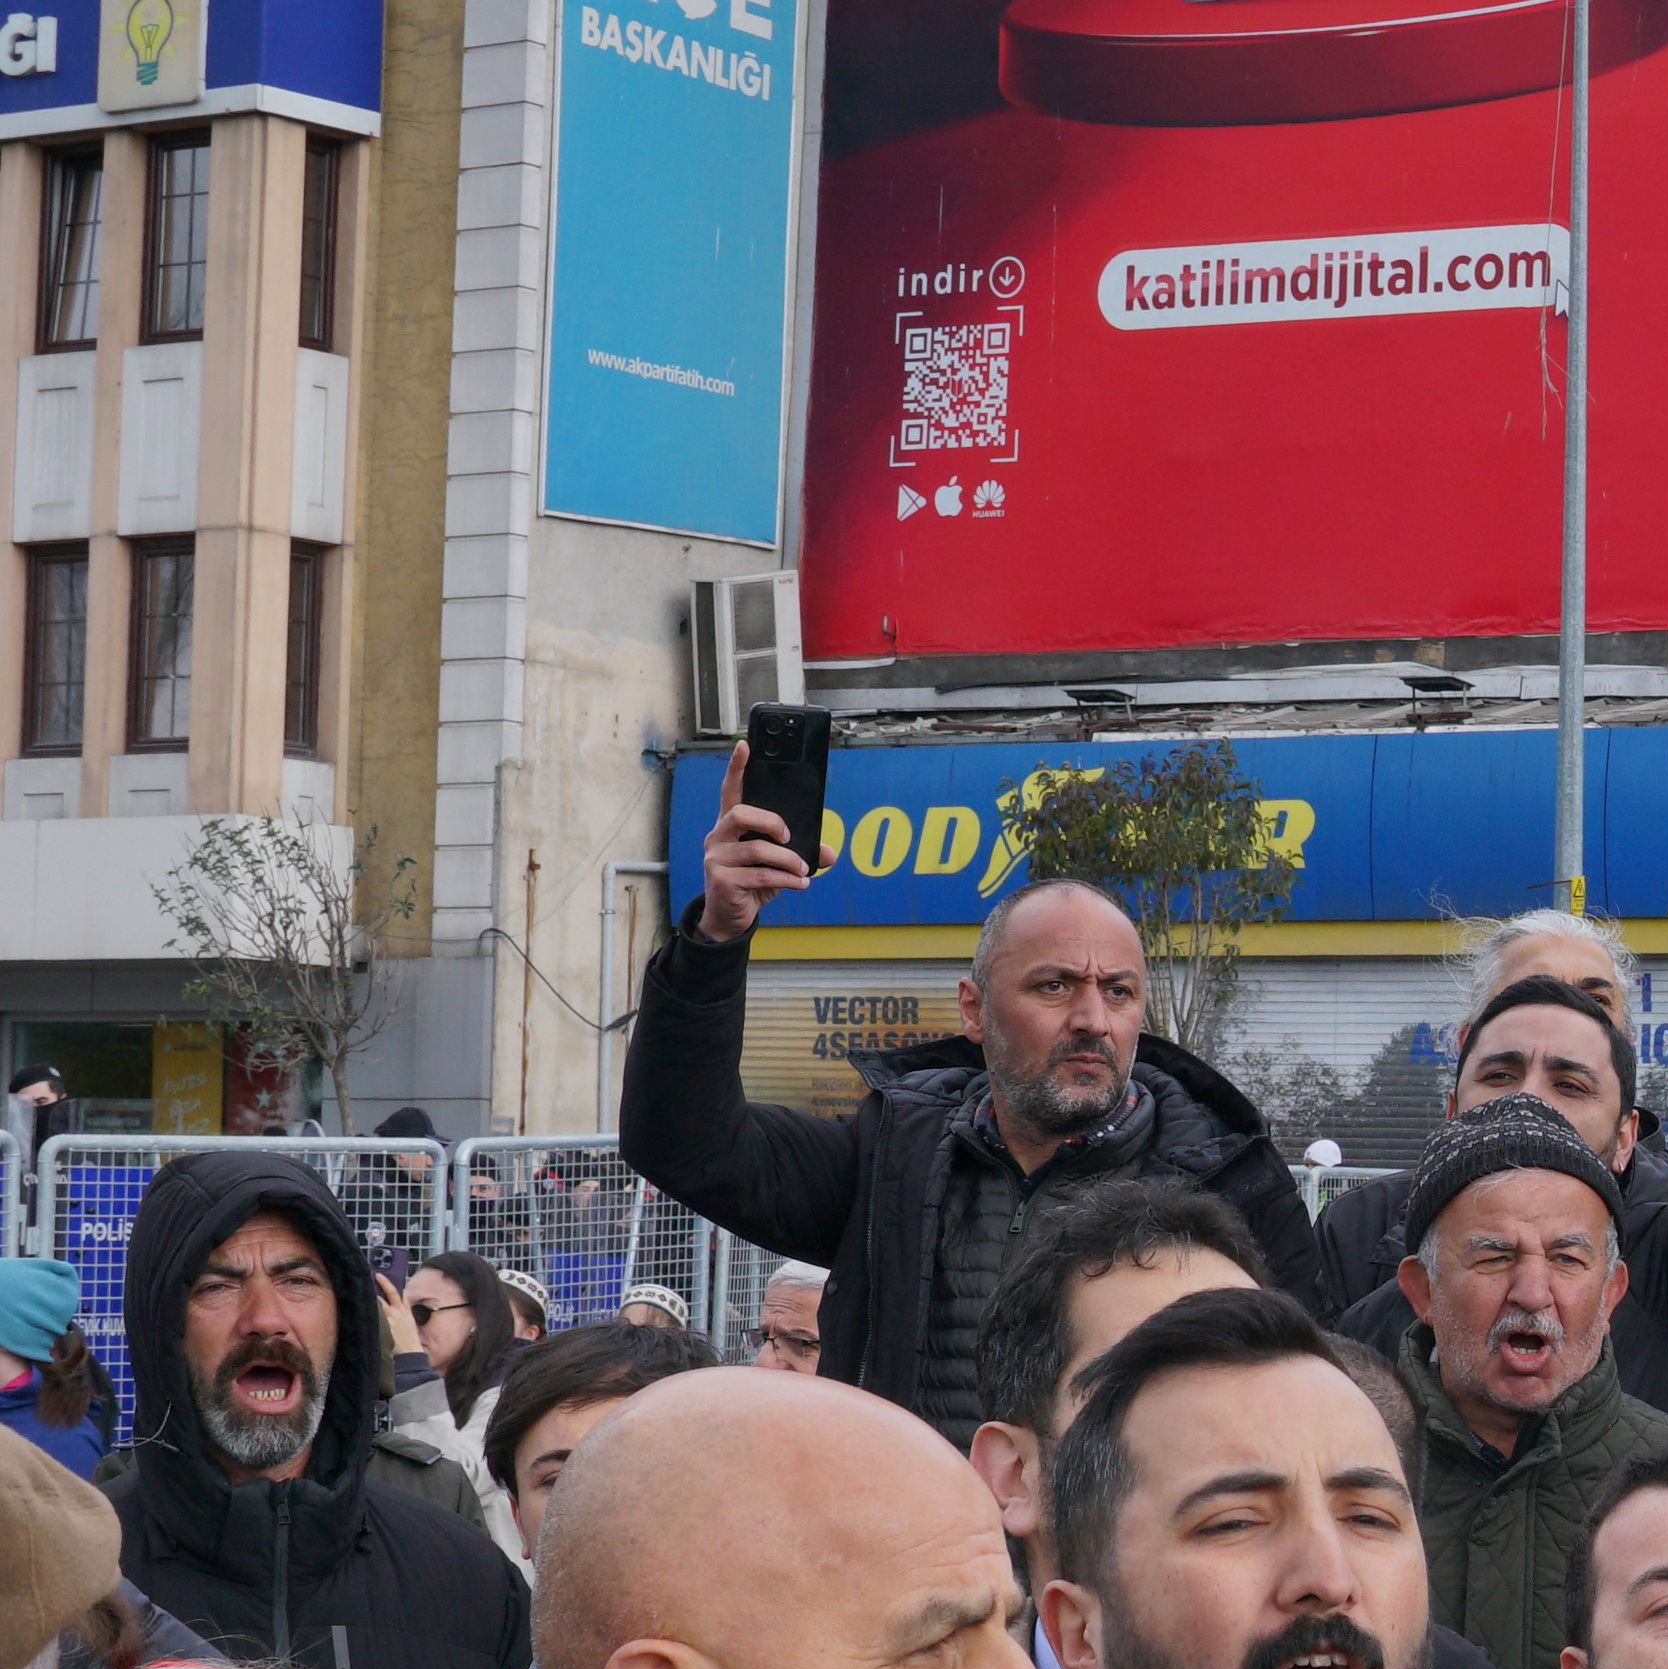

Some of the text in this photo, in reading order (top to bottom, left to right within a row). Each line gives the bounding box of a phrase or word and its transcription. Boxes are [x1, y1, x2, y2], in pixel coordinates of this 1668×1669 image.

[581, 5, 771, 101] BAŞKANLIĞI
[898, 263, 984, 297] indir
[1125, 246, 1551, 308] katilimdijital.com
[587, 348, 735, 397] www.akpartifatih.com
[813, 996, 919, 1025] VECTOR
[812, 1031, 956, 1060] 4SEAS
